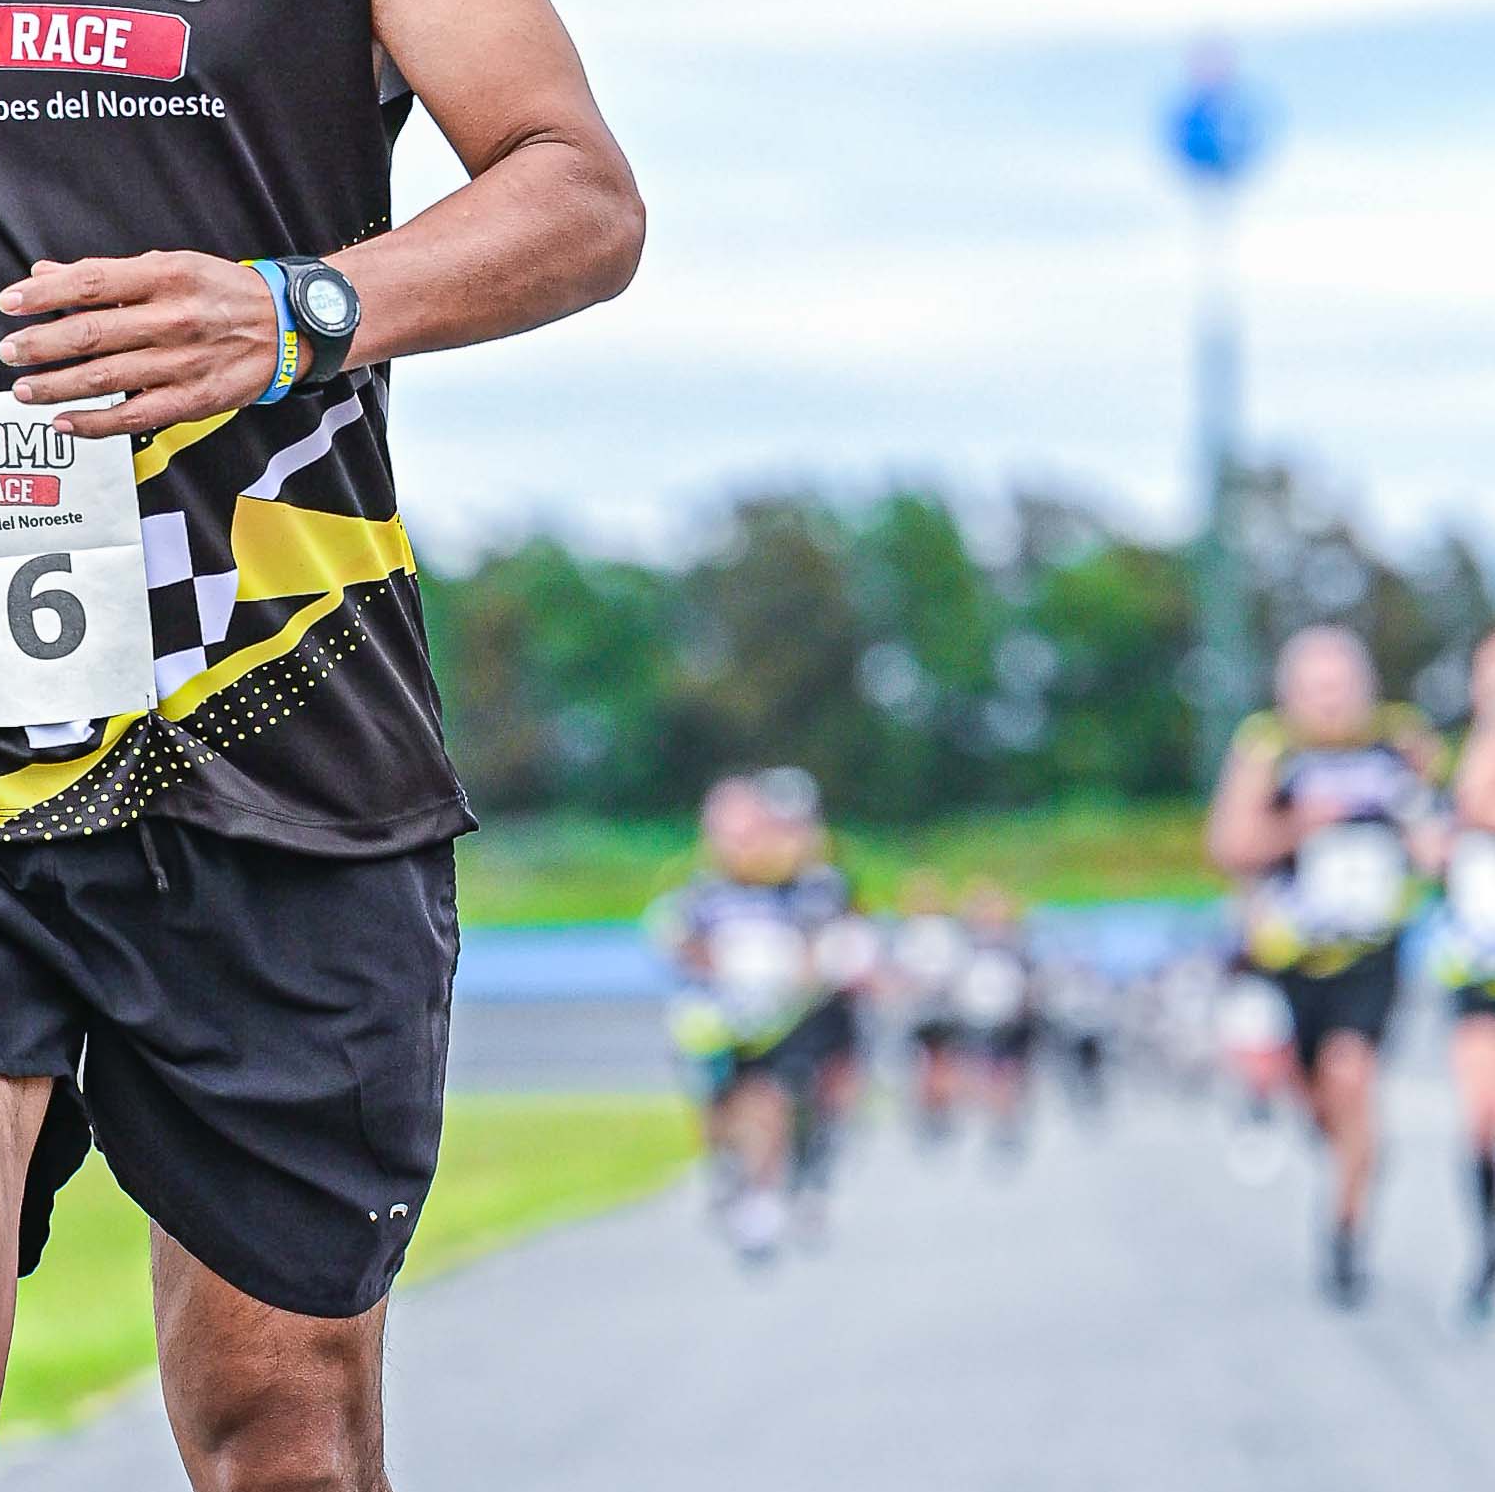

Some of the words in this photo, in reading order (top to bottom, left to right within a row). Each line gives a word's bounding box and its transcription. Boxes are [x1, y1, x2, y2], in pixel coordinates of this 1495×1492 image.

[10, 12, 133, 69] RACE
[46, 89, 90, 120] del
[97, 89, 226, 118] Noroeste
[18, 511, 83, 529] Noroeste
